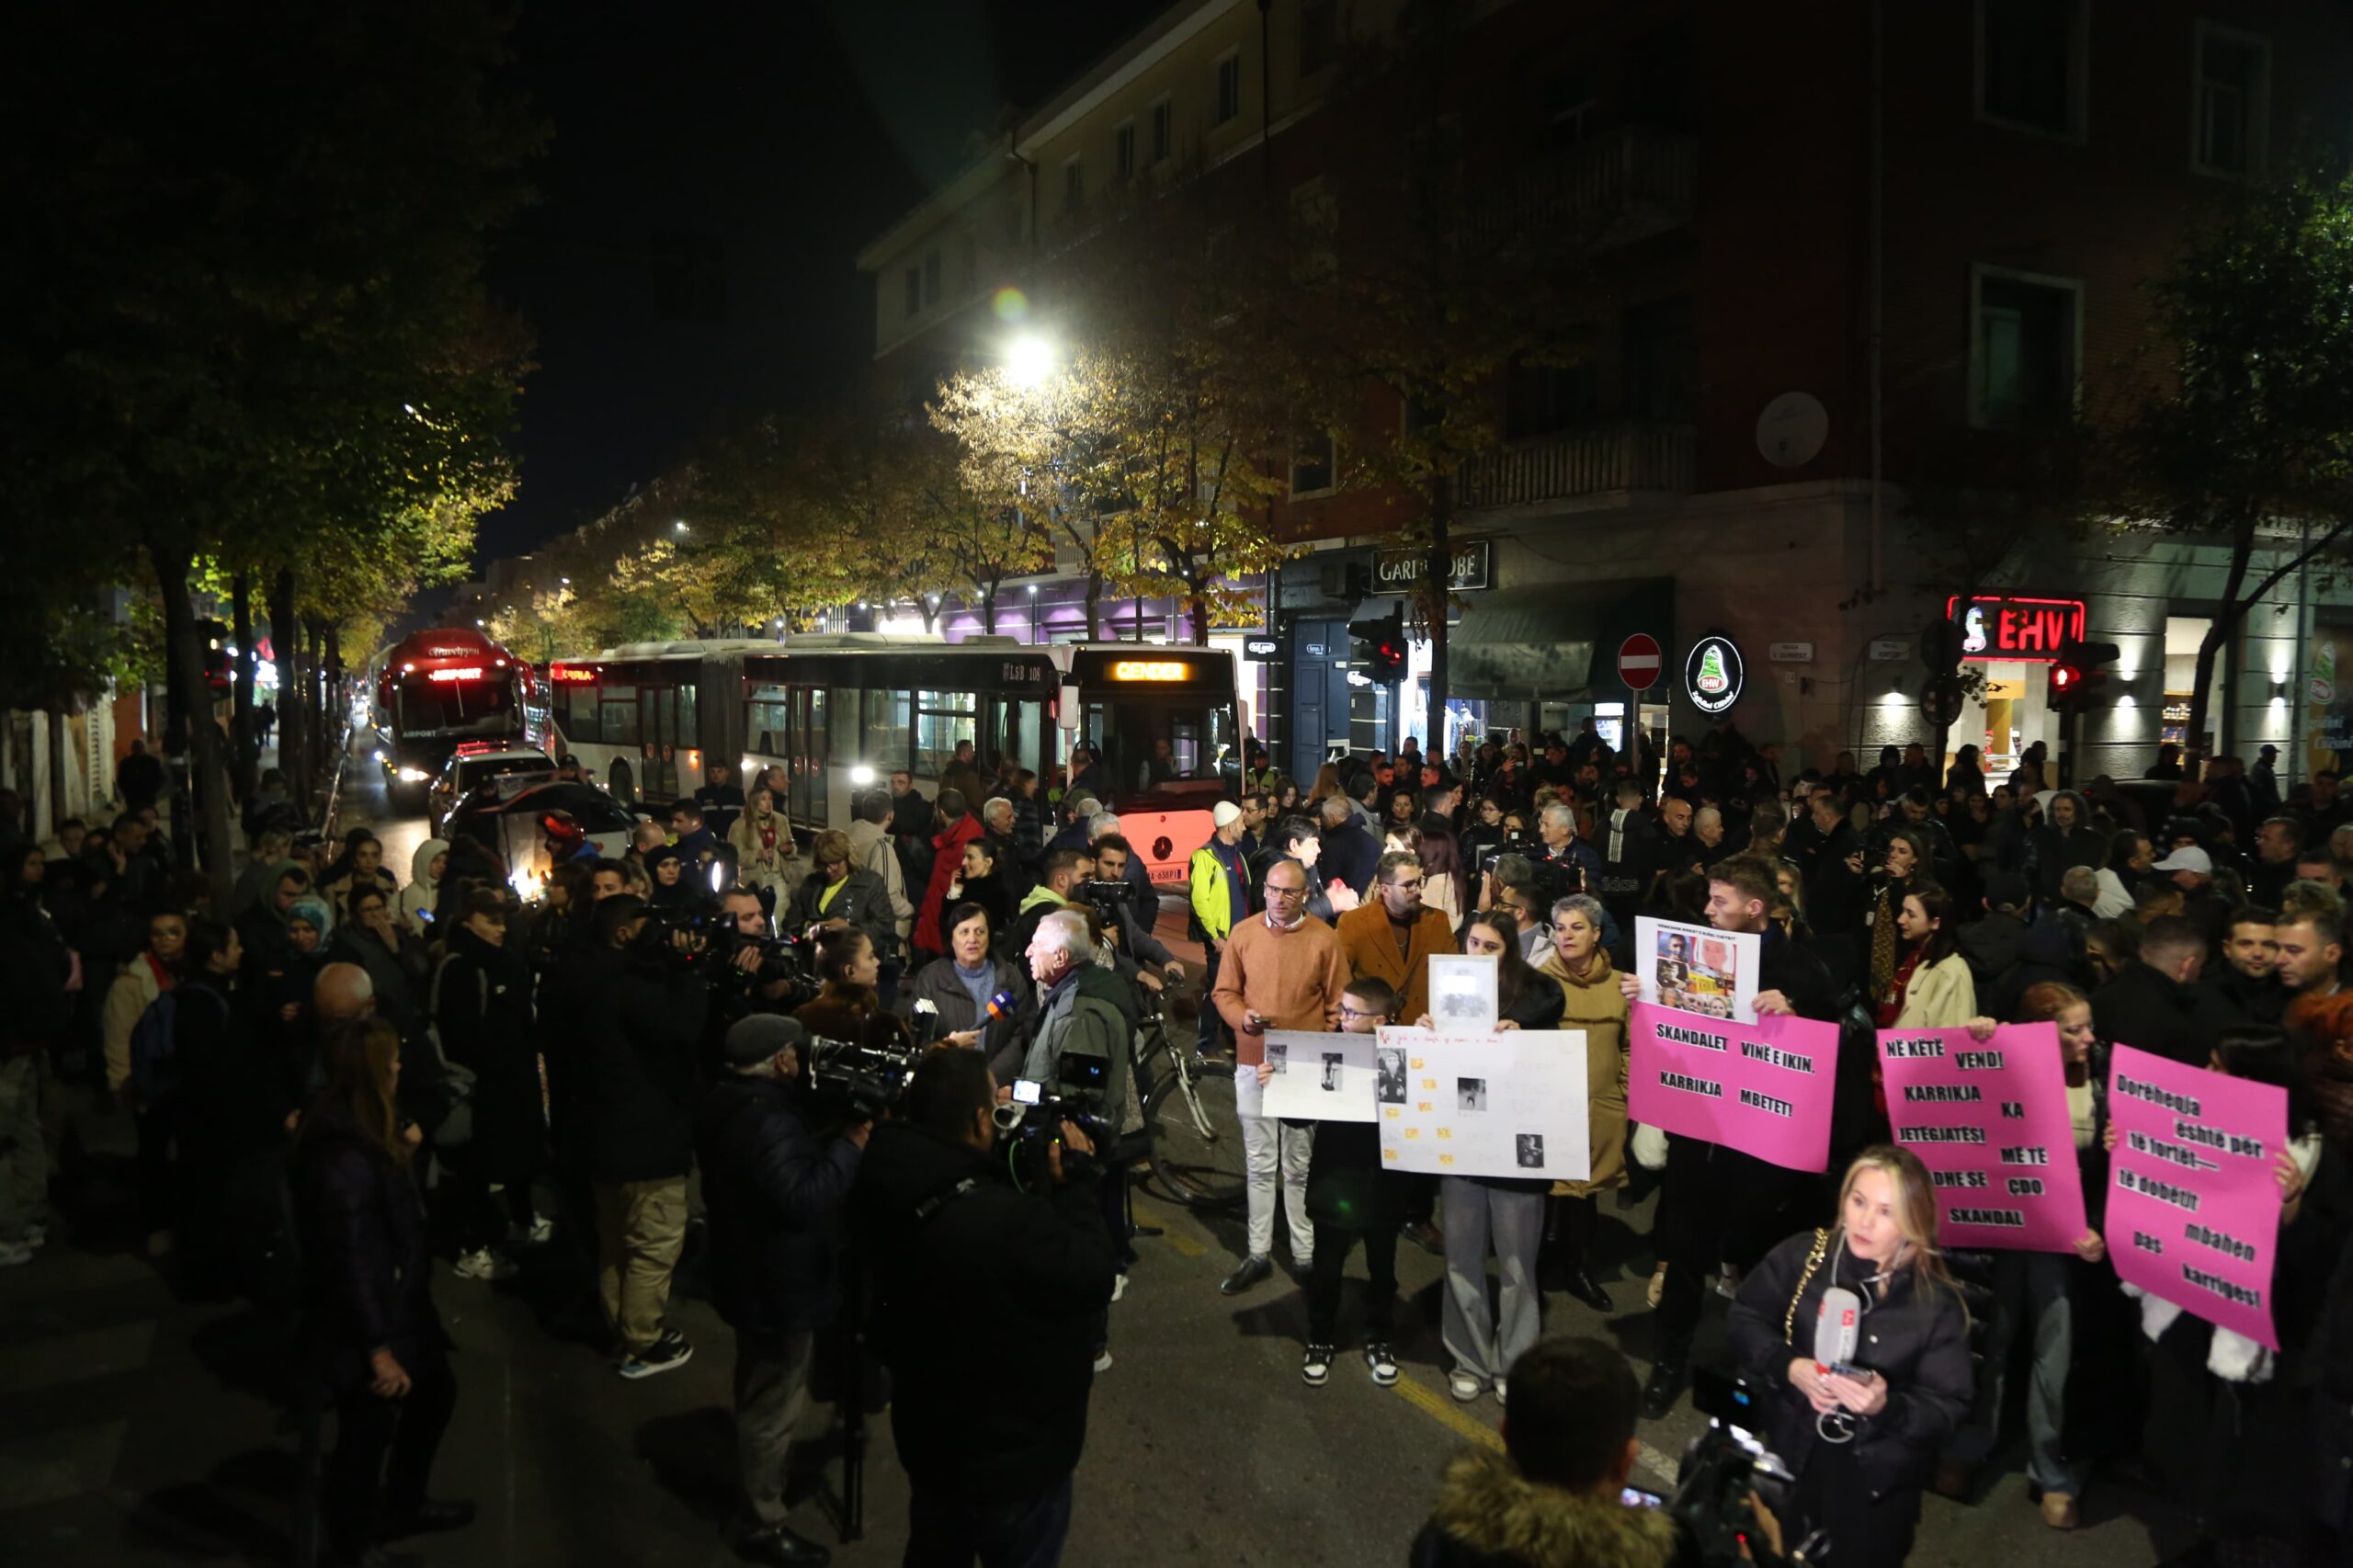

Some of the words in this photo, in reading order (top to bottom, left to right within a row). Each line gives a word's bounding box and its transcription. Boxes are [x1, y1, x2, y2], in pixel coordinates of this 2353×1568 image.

[1700, 677, 1720, 688] EHW
[1656, 1023, 1729, 1051] SKANDALET
[1741, 1041, 1770, 1062] VINË
[1773, 1050, 1781, 1065] E
[1782, 1051, 1815, 1074] IKIN.
[1886, 1039, 1904, 1057] NË
[1908, 1038, 1945, 1057] KËTË
[1955, 1051, 2004, 1069] VEND!
[1660, 1071, 1722, 1097] KARRIKJA
[1740, 1089, 1793, 1118] MBETET!
[1904, 1085, 1982, 1102] KARRIKJA
[2001, 1102, 2025, 1119] KA
[2117, 1074, 2200, 1117] Dorëheqja
[1900, 1126, 1986, 1142] JETËGJATËSI
[2001, 1145, 2026, 1164] MË
[2028, 1146, 2047, 1164] TË
[2230, 1136, 2262, 1158] për
[1969, 1172, 1987, 1187] SE
[2007, 1178, 2042, 1197] ÇDO
[1949, 1209, 2024, 1225] SKANDAL
[2133, 1231, 2163, 1254] pas
[2185, 1223, 2256, 1262] mbahen
